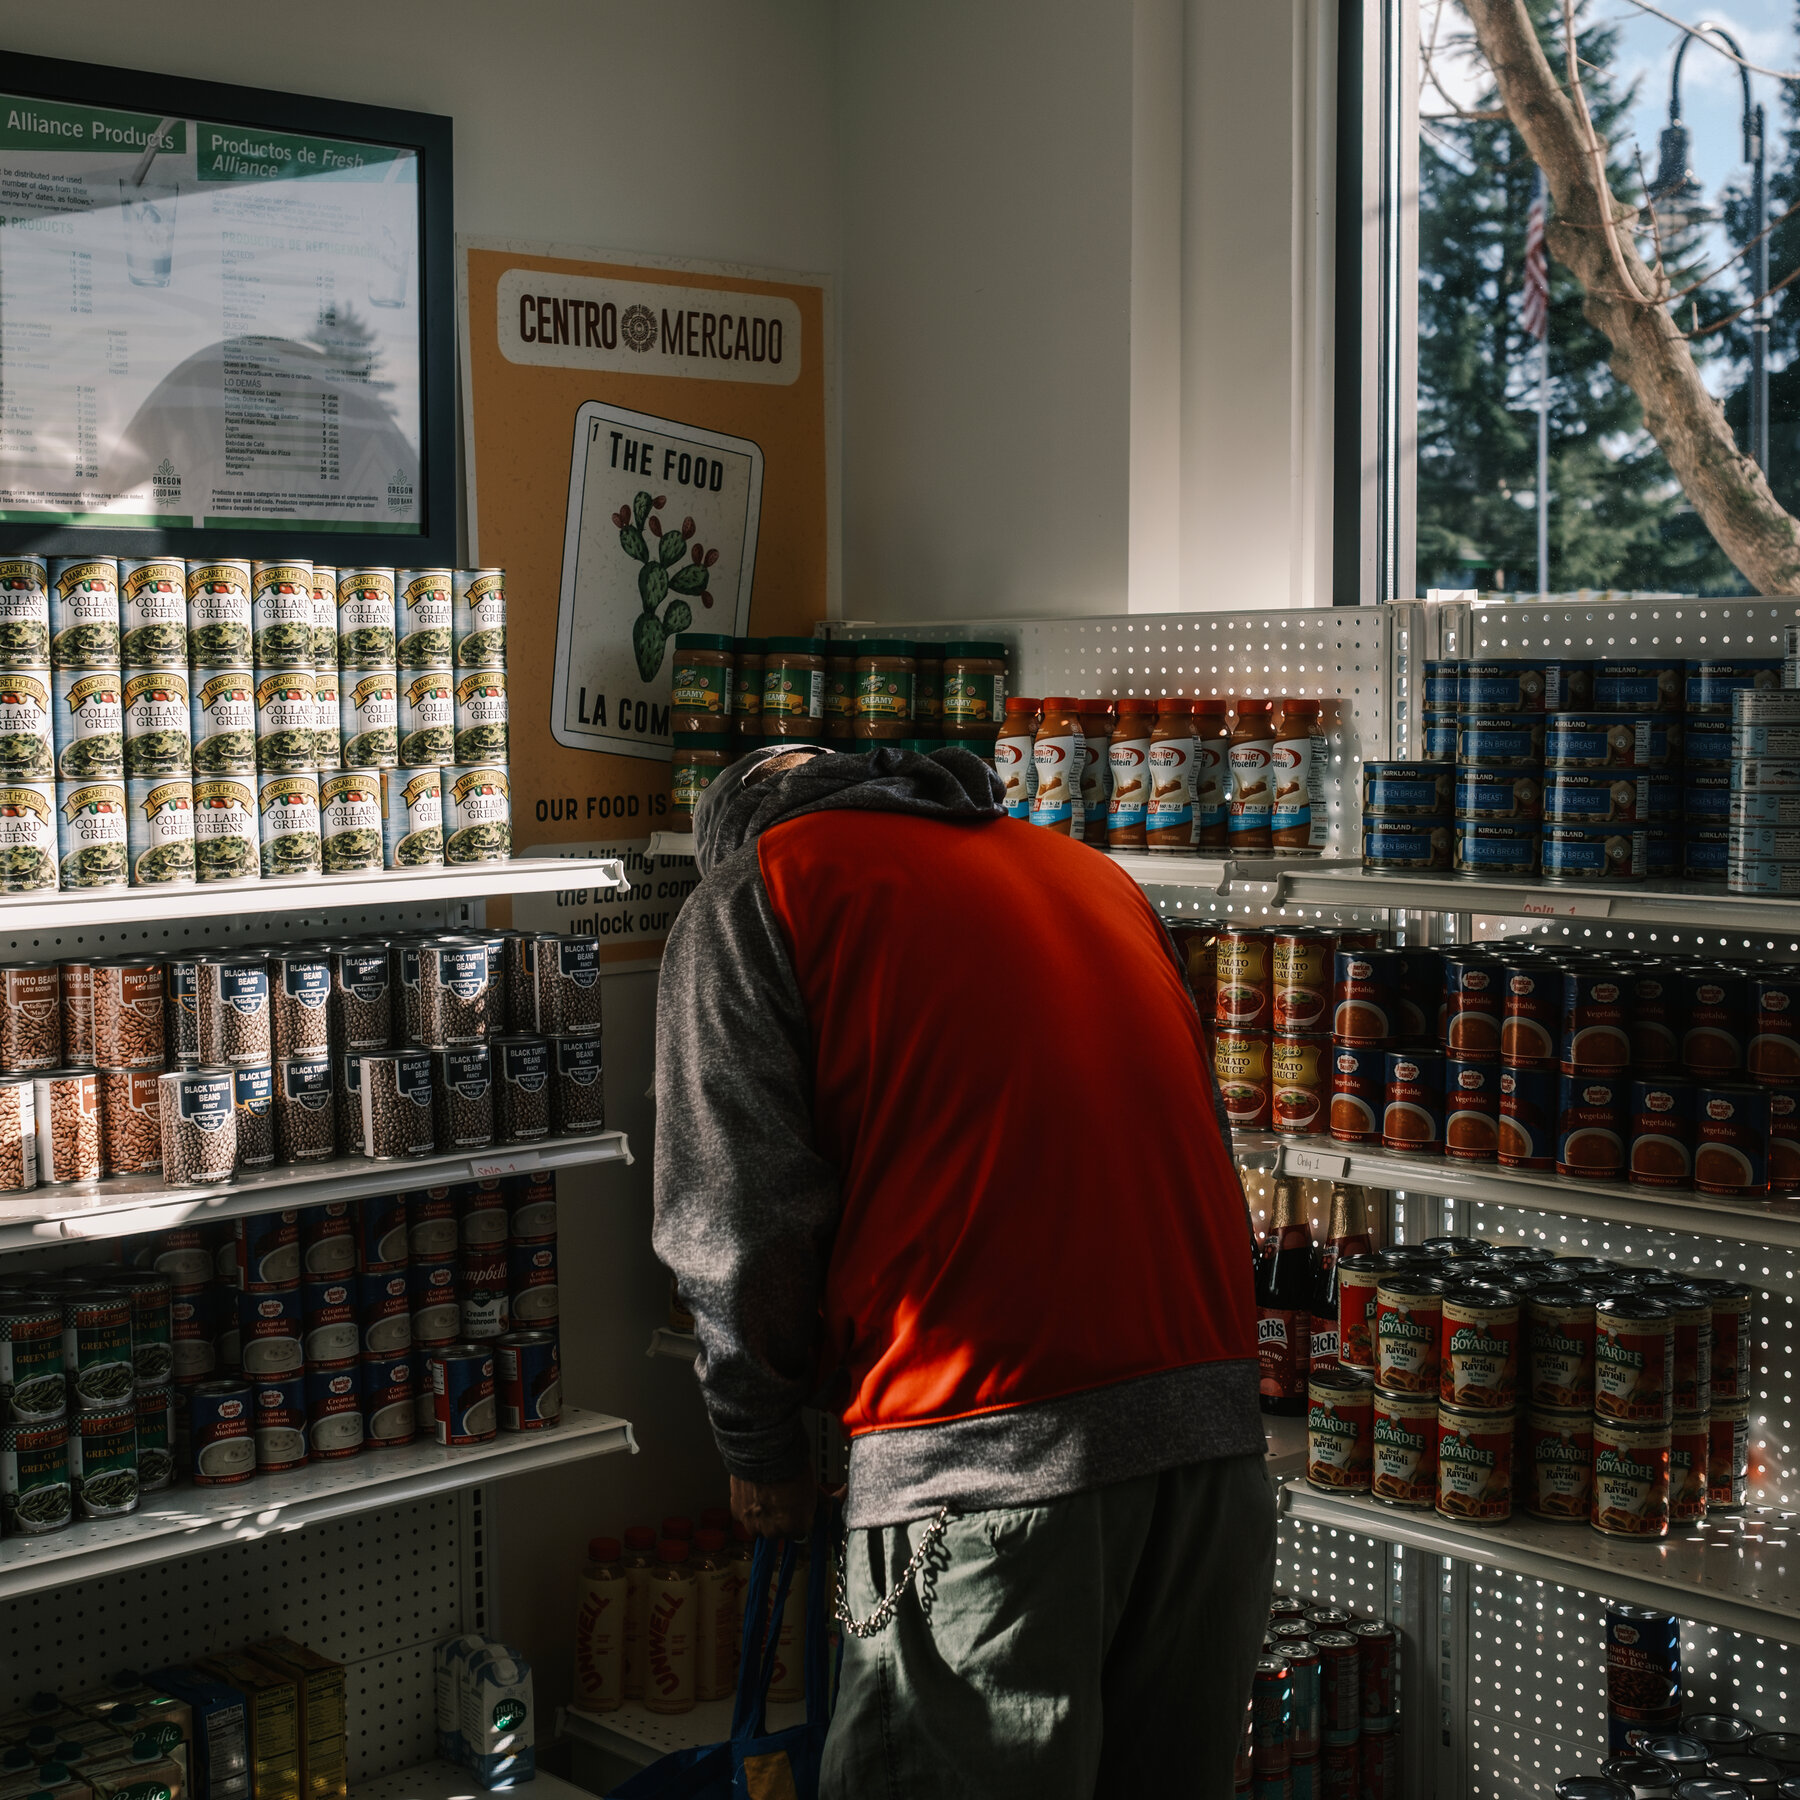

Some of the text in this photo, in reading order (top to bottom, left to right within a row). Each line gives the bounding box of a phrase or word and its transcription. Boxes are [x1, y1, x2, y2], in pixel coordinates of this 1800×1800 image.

[7, 110, 174, 149] Alliance Products
[212, 134, 364, 171] Productos de Fresh
[212, 154, 279, 178] Alliance
[4, 168, 82, 184] be distributed and used
[2, 180, 27, 188] number
[38, 183, 53, 191] days
[2, 190, 19, 199] enjoy
[35, 193, 55, 202] dates,
[11, 216, 74, 235] PRODUCTS
[519, 294, 617, 350] CENTRO
[661, 308, 782, 365] MERCADO
[225, 378, 262, 388] LO DEMÁS
[592, 422, 599, 443] 1
[610, 431, 724, 492] THE FOOD
[153, 476, 181, 486] OREGON
[153, 488, 181, 497] FOOD BANK
[388, 486, 413, 494] OREGON
[66, 566, 101, 582] MARGARET
[190, 569, 224, 586] MARGARET
[197, 609, 244, 619] GREENS
[264, 609, 308, 619] GREENS
[349, 614, 390, 624] GREENS
[675, 690, 704, 698] CREAMY
[861, 697, 893, 705] CREAMY
[579, 687, 607, 727] LA
[271, 715, 313, 725] GREENS
[472, 710, 508, 720] GREENS
[1476, 720, 1511, 728] KIRKLAND
[1495, 739, 1521, 748] BREAST
[1230, 751, 1260, 761] Premier
[1231, 760, 1258, 768] Protein
[463, 799, 505, 810] COLLARD
[536, 794, 667, 822] OUR FOOD IS
[194, 813, 247, 823] COLLARD
[467, 810, 503, 819] GREENS
[196, 823, 243, 833] GREENS
[273, 819, 316, 829] GREENS
[556, 887, 588, 907] the
[570, 910, 670, 936] unlock our
[443, 952, 485, 962] BLACK TURTLE
[456, 962, 476, 971] BEANS
[1274, 960, 1309, 971] TOMATO
[459, 970, 474, 978] FANCY
[1276, 970, 1304, 980] SAUCE
[12, 976, 36, 987] PINTO
[450, 1054, 471, 1064] BLACK
[463, 1063, 482, 1073] BEANS
[1218, 1065, 1246, 1074] SAUCE
[1461, 1073, 1483, 1081] American
[184, 1081, 230, 1094] BLACK TURTLE
[1391, 1087, 1421, 1096] Vegetable
[199, 1093, 221, 1102] BEANS
[202, 1102, 219, 1110] FANCY
[1709, 1103, 1731, 1113] American
[1711, 1109, 1729, 1118] Beauty
[1703, 1127, 1737, 1136] Vegetable
[1297, 1153, 1320, 1171] Only 1
[1257, 1320, 1285, 1338] lch's
[1455, 1328, 1473, 1340] Chef
[81, 1339, 110, 1350] GREEN
[1450, 1336, 1510, 1355] BOYARDEE
[1461, 1361, 1495, 1374] Ravioli
[222, 1403, 240, 1411] American
[216, 1420, 246, 1430] Cream of
[214, 1427, 248, 1437] Mushroom
[1442, 1436, 1457, 1446] Chef
[1439, 1443, 1494, 1465] BOYARDEE
[1454, 1464, 1469, 1473] Beef
[1596, 1458, 1654, 1480] BOYARDEE
[1446, 1468, 1478, 1483] Ravioli
[1604, 1483, 1638, 1498] Ravioli
[650, 1591, 684, 1695] UNWELL
[1609, 1644, 1648, 1660] Dark Red
[1629, 1657, 1664, 1673] Beans
[496, 1702, 515, 1714] nut
[496, 1709, 524, 1726] pods
